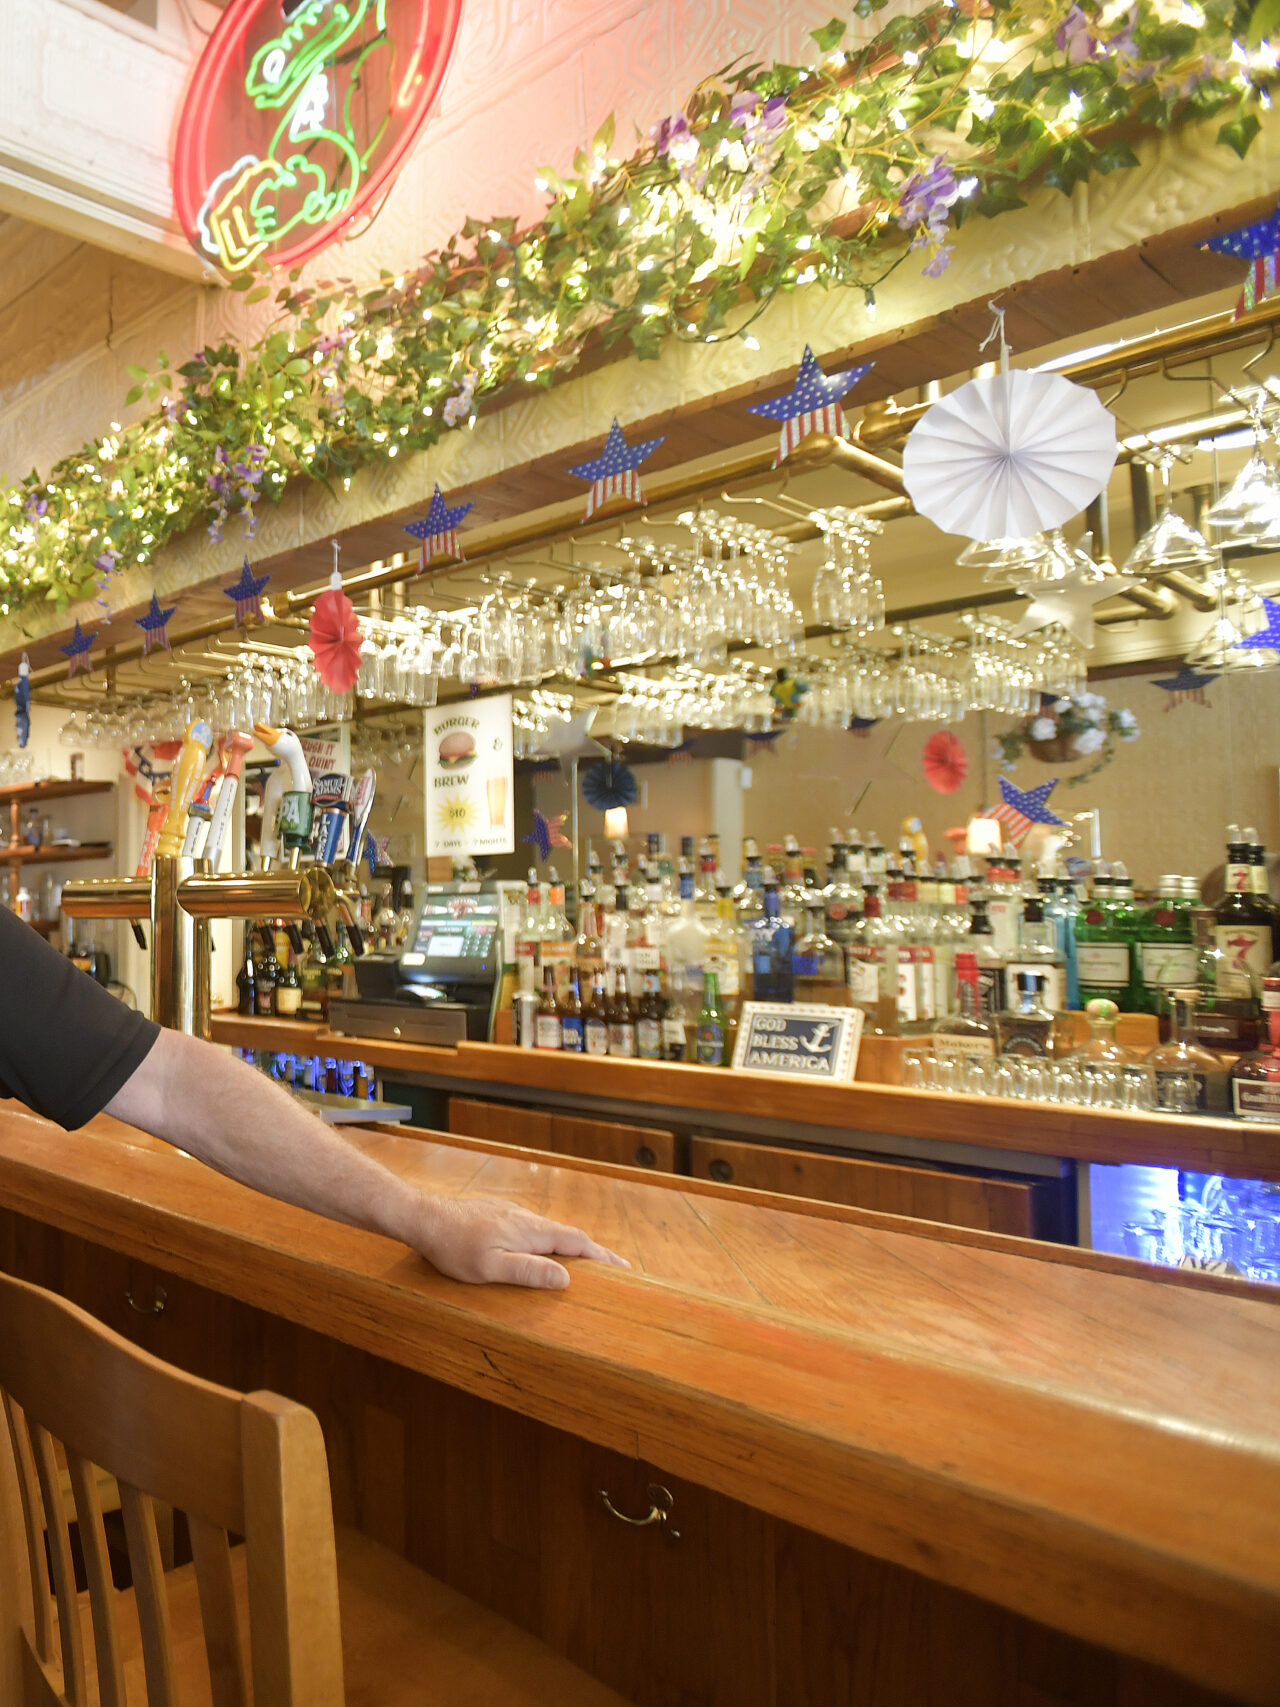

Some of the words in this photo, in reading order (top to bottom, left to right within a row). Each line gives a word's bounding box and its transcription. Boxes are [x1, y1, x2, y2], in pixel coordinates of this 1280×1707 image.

[434, 716, 480, 736] BURGER
[326, 743, 336, 756] IT
[309, 756, 336, 770] QUINT
[313, 777, 344, 789] SAMUEL
[434, 774, 469, 788] BREW
[315, 785, 342, 795] ADAMS
[283, 795, 300, 824] PA
[1232, 868, 1248, 890] 7
[756, 1016, 787, 1032] GOD
[752, 1033, 799, 1051] BLESS
[750, 1050, 830, 1071] AMERICA
